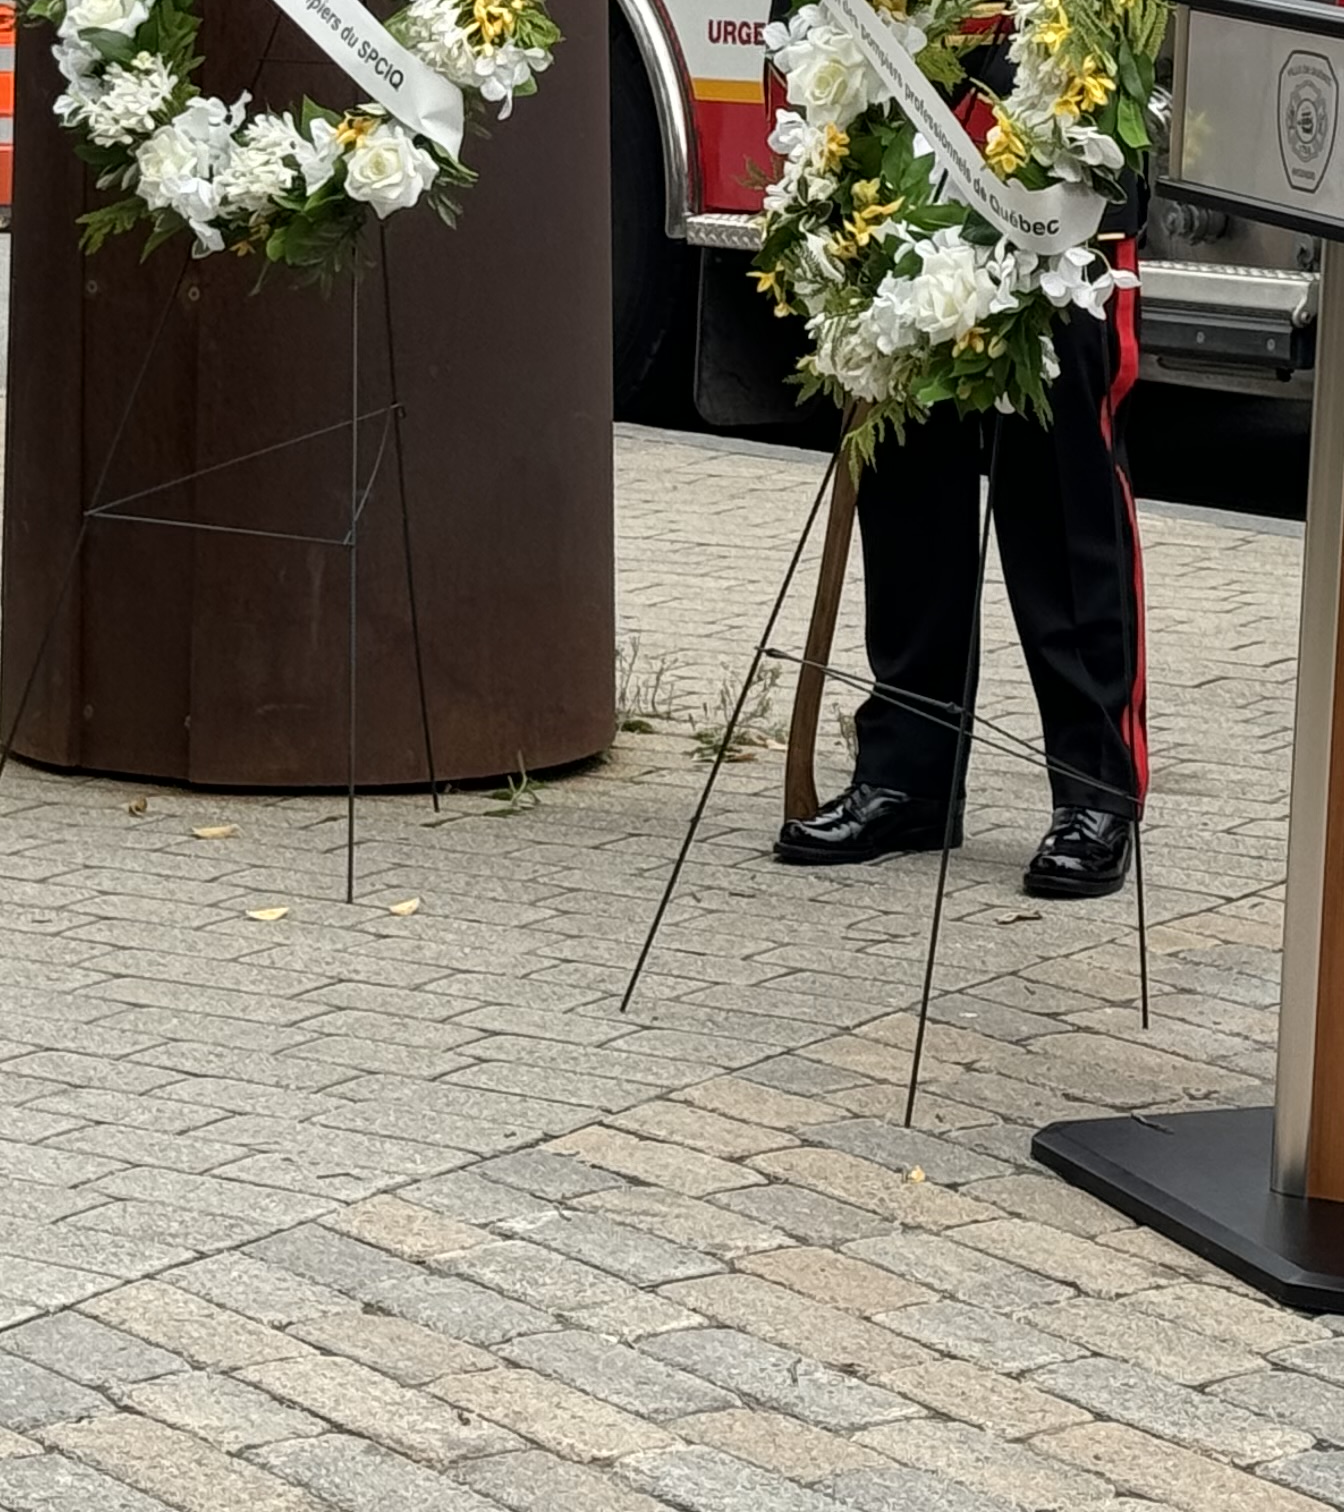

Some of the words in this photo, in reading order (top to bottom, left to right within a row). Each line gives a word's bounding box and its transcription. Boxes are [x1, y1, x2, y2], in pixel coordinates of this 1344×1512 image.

[340, 22, 361, 52] du
[356, 40, 405, 92] SPCIQ
[708, 20, 767, 46] URGE
[904, 82, 972, 184] professionnels
[973, 177, 988, 203] de
[988, 193, 1060, 237] Québec
